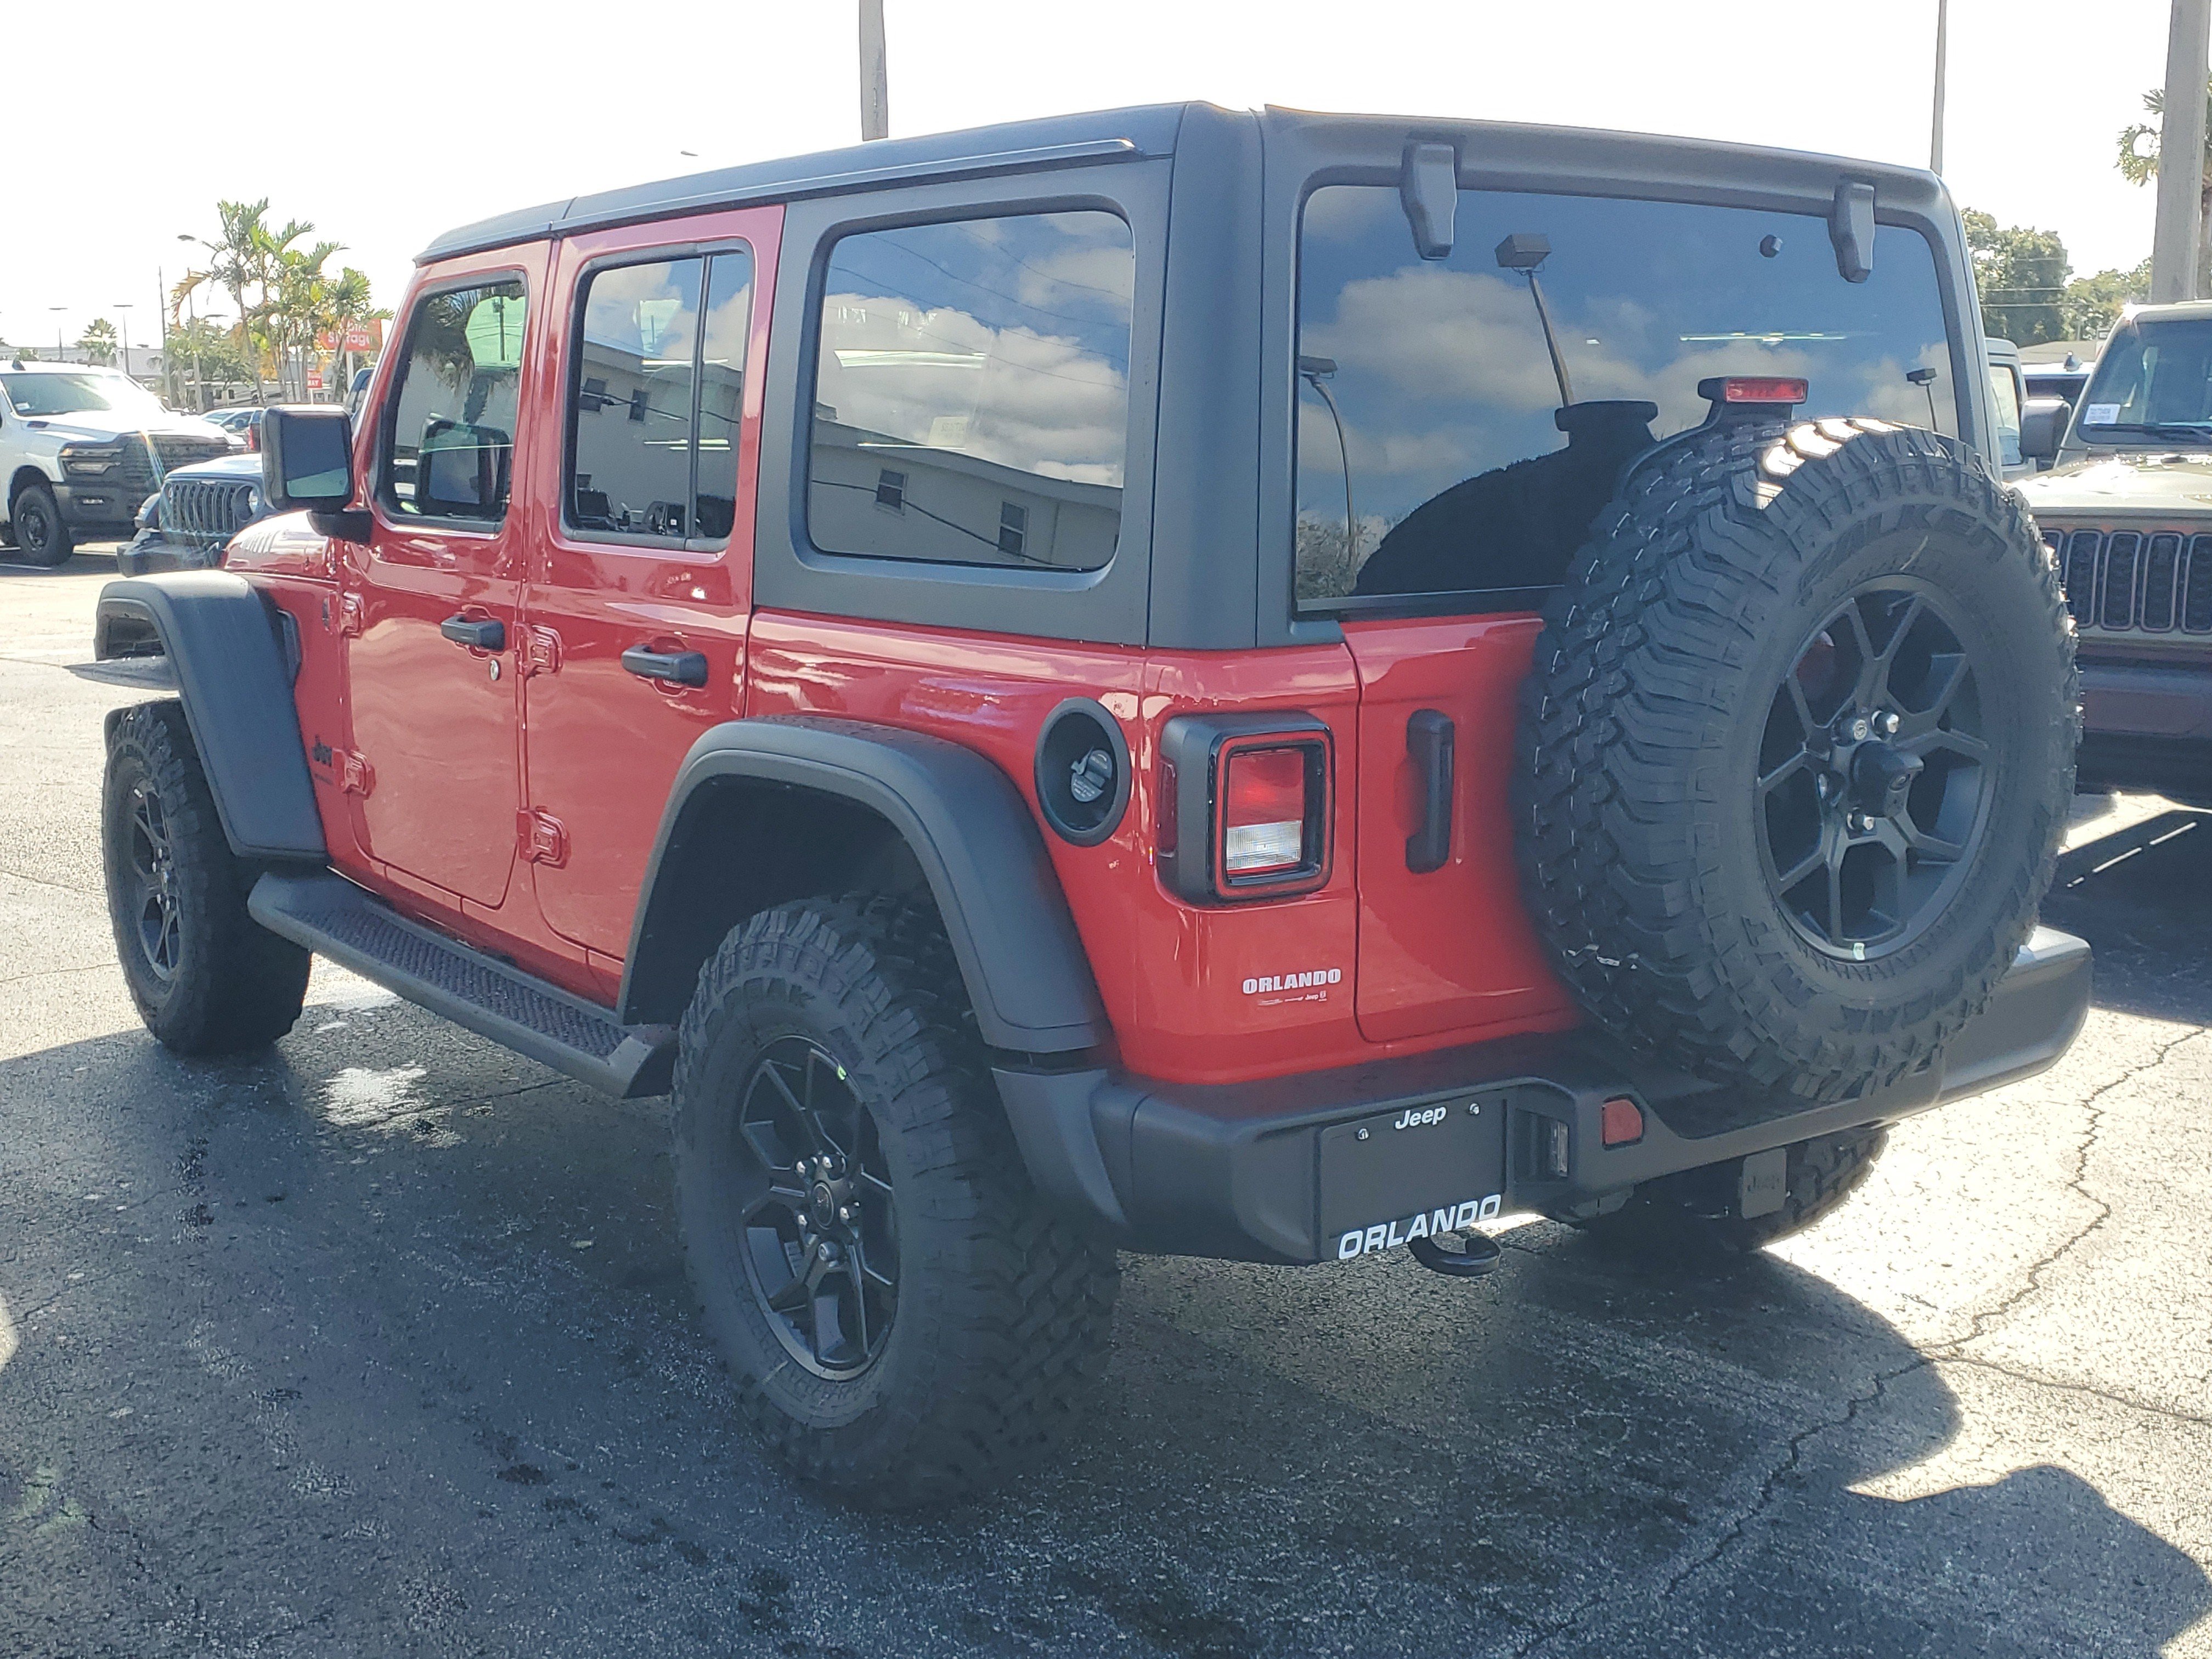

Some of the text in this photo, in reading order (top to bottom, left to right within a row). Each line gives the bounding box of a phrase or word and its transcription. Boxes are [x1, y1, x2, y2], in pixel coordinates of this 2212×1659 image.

[1243, 968, 1341, 994] ORLANDO
[1395, 1106, 1447, 1130] Jeep
[1339, 1194, 1502, 1260] ORLANDO
